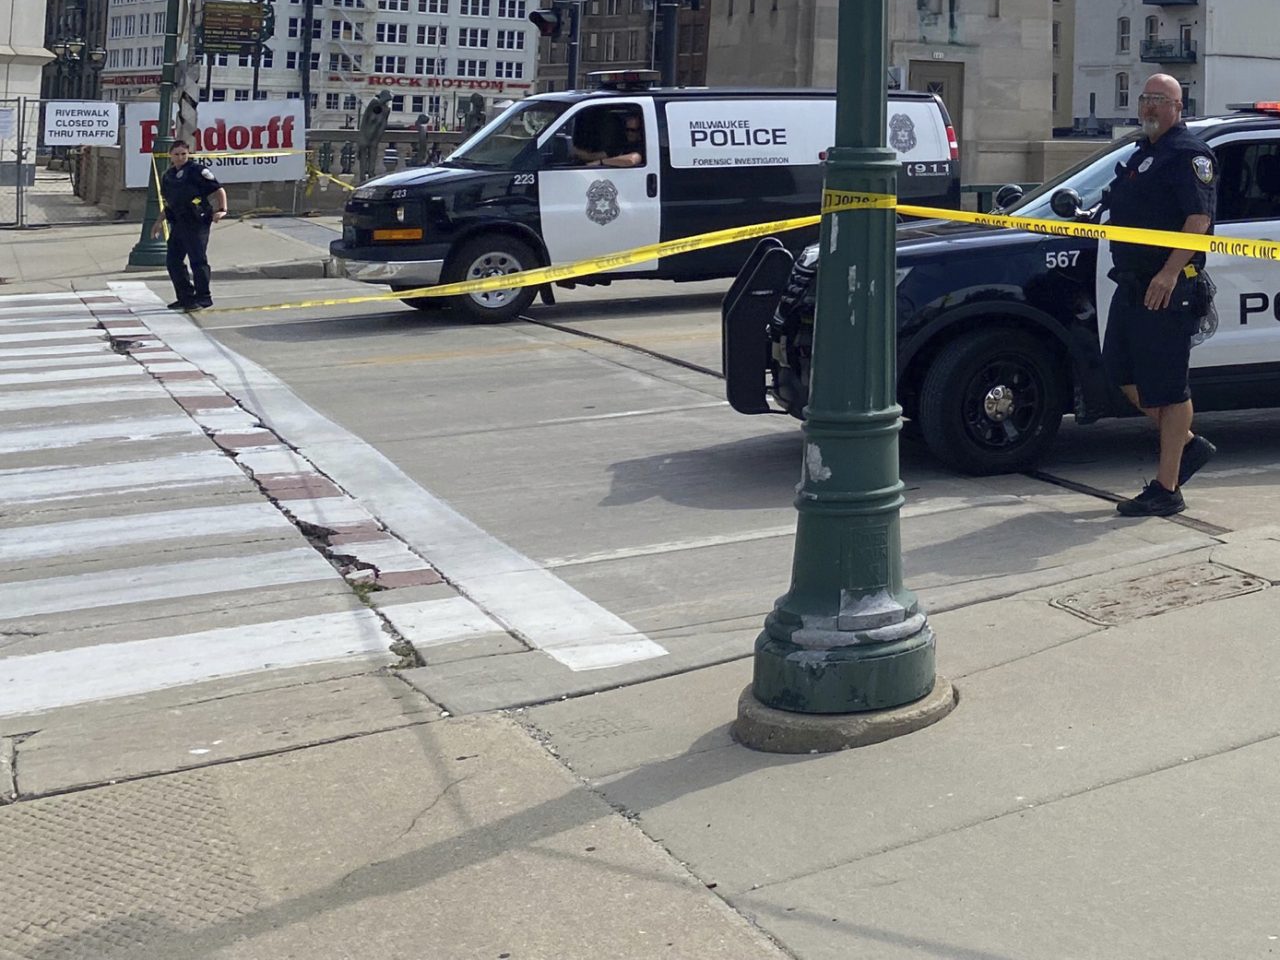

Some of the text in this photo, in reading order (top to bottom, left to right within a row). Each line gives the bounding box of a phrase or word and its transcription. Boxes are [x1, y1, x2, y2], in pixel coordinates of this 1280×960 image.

[368, 76, 504, 90] ROCK BOTTOM
[55, 109, 109, 117] RIVERWALK
[55, 119, 109, 127] CLOSED TO
[689, 120, 750, 129] MILWAUKEE
[48, 130, 115, 138] THRU TRAFFIC
[690, 128, 787, 147] POLICE
[216, 157, 249, 167] SINCE
[693, 157, 789, 166] FORENSIC INVESTIGATION
[915, 163, 949, 173] 911
[513, 174, 535, 185] 223
[392, 190, 407, 198] 223
[1210, 241, 1249, 257] POLICE
[1252, 245, 1277, 260] LINE
[1045, 250, 1081, 269] 567
